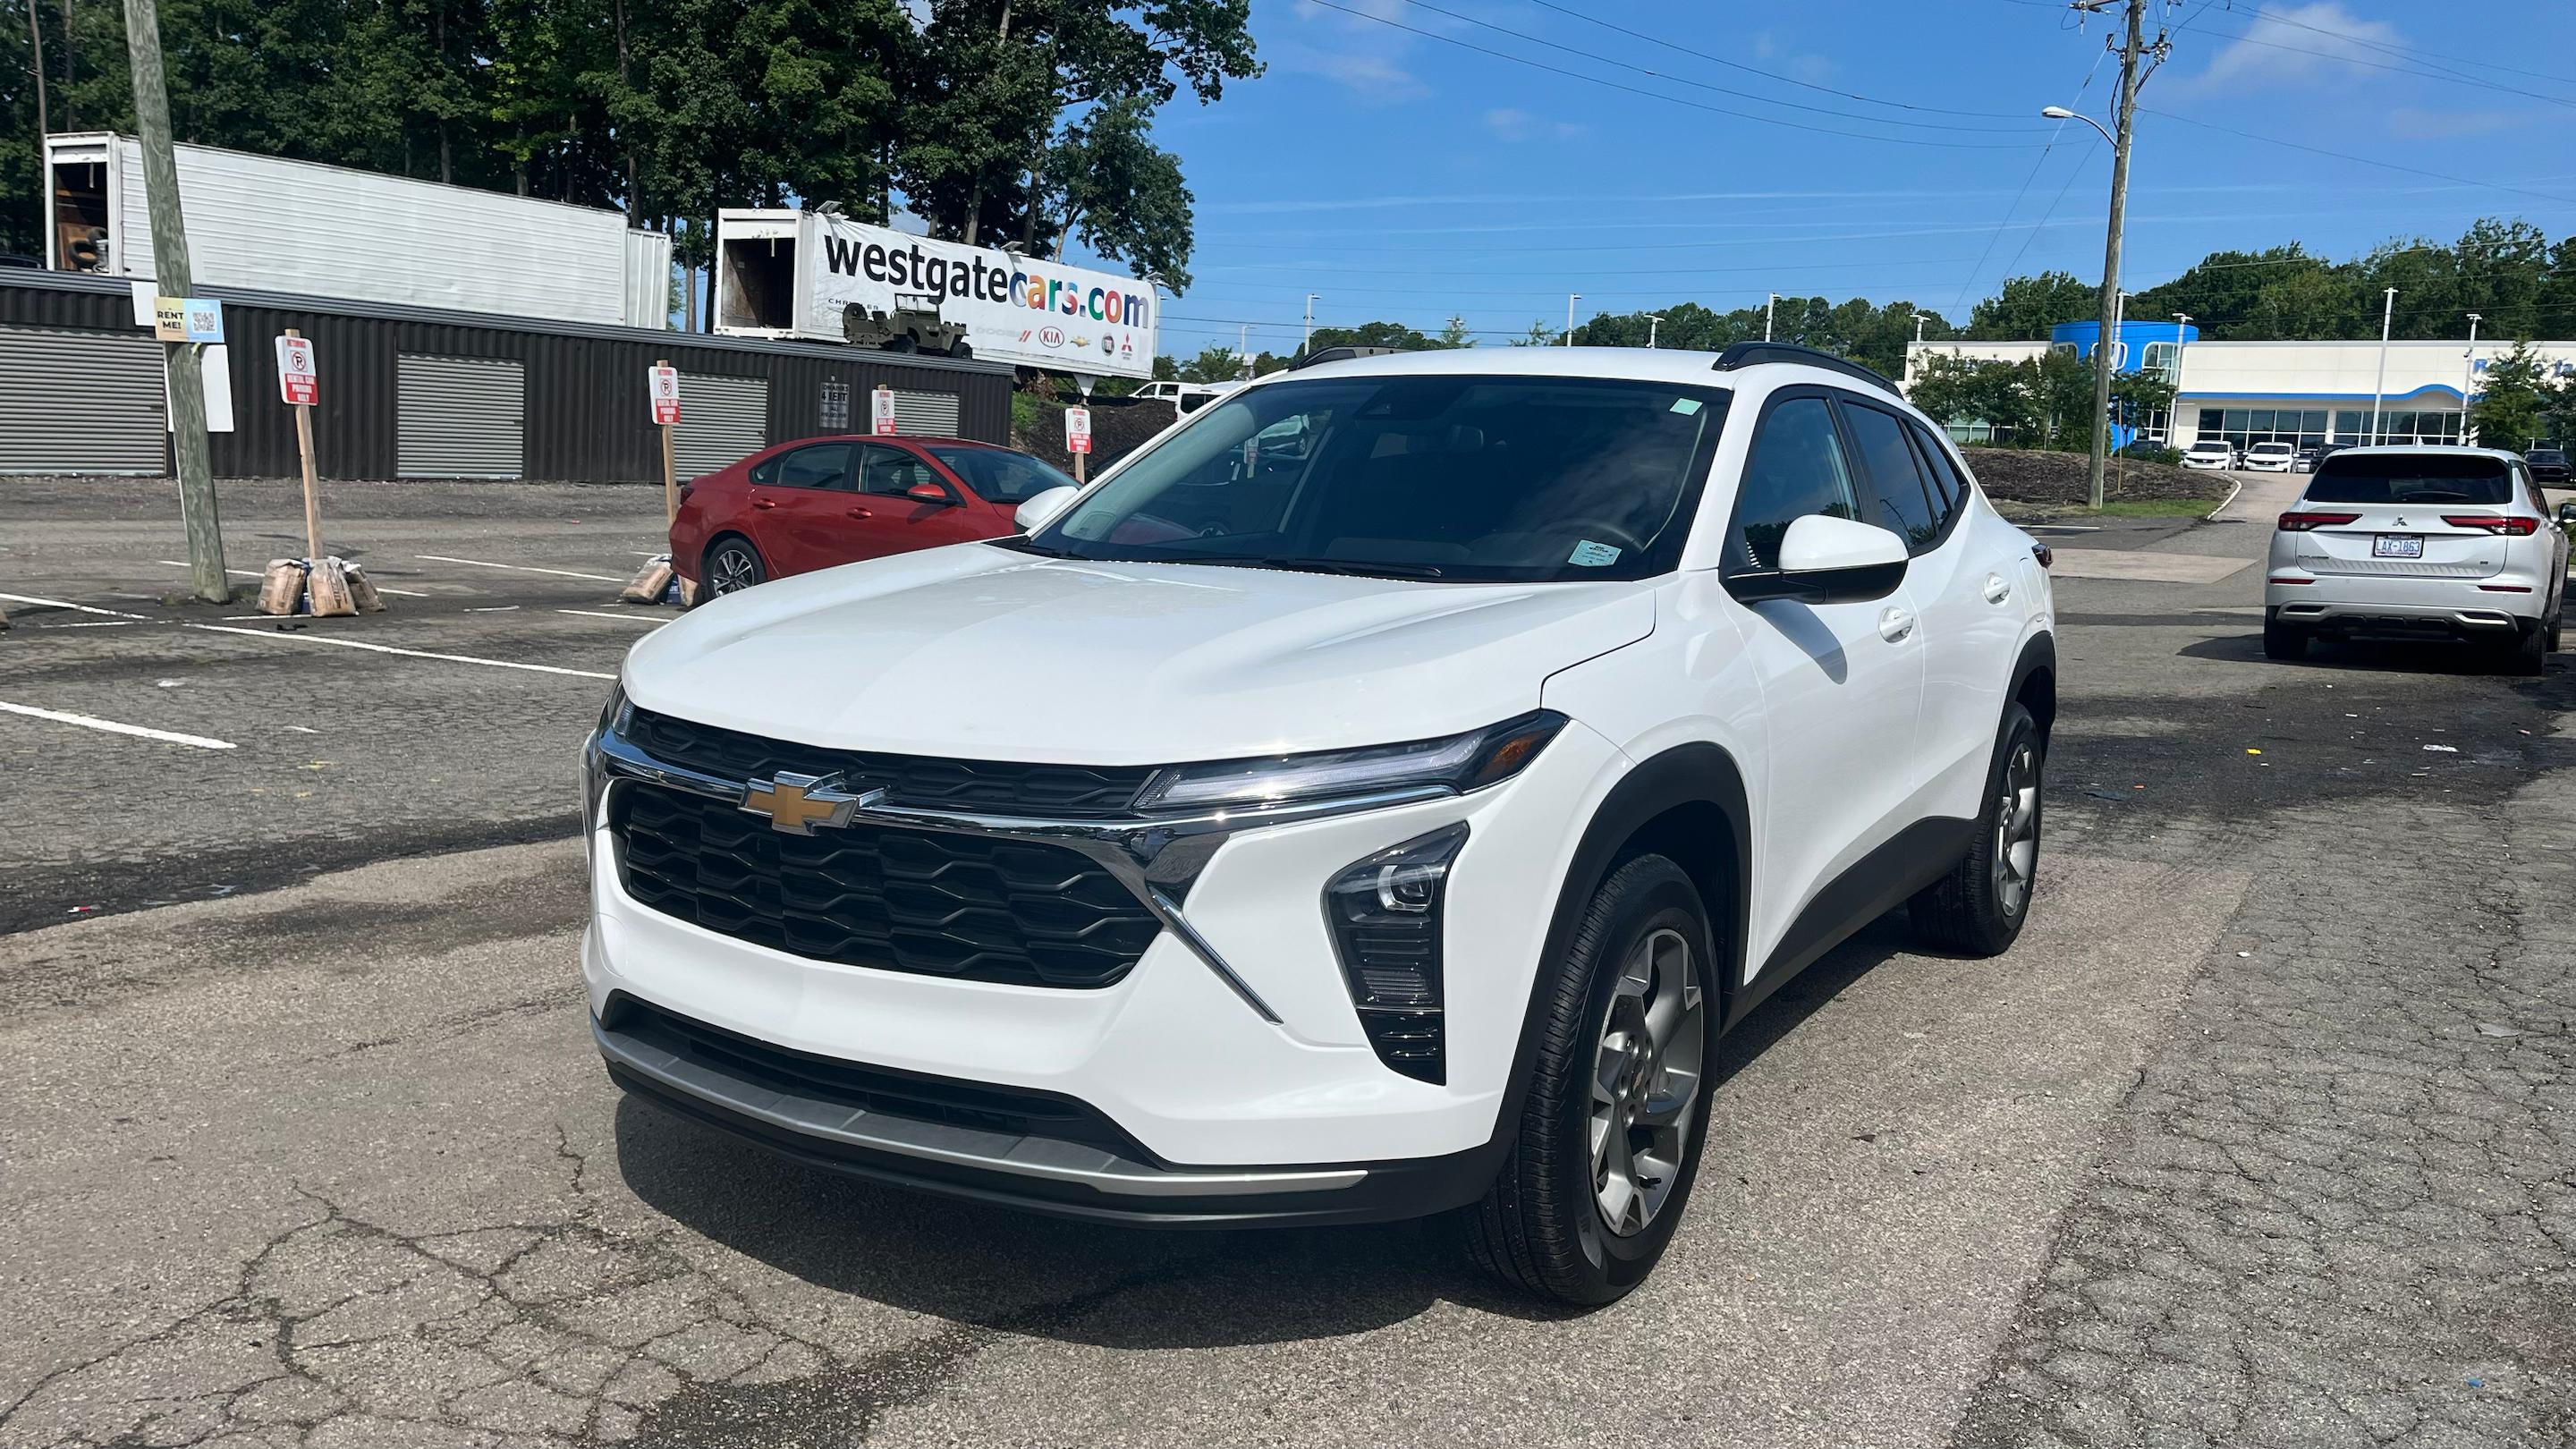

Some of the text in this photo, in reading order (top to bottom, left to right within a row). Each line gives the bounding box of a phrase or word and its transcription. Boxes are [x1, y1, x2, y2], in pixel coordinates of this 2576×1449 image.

[823, 234, 1149, 330] westgatecars.com
[828, 298, 879, 310] CHRER
[157, 310, 184, 319] RENT
[163, 321, 182, 329] ME!
[1042, 331, 1061, 344] KIA
[2376, 540, 2421, 552] LAX-1863
